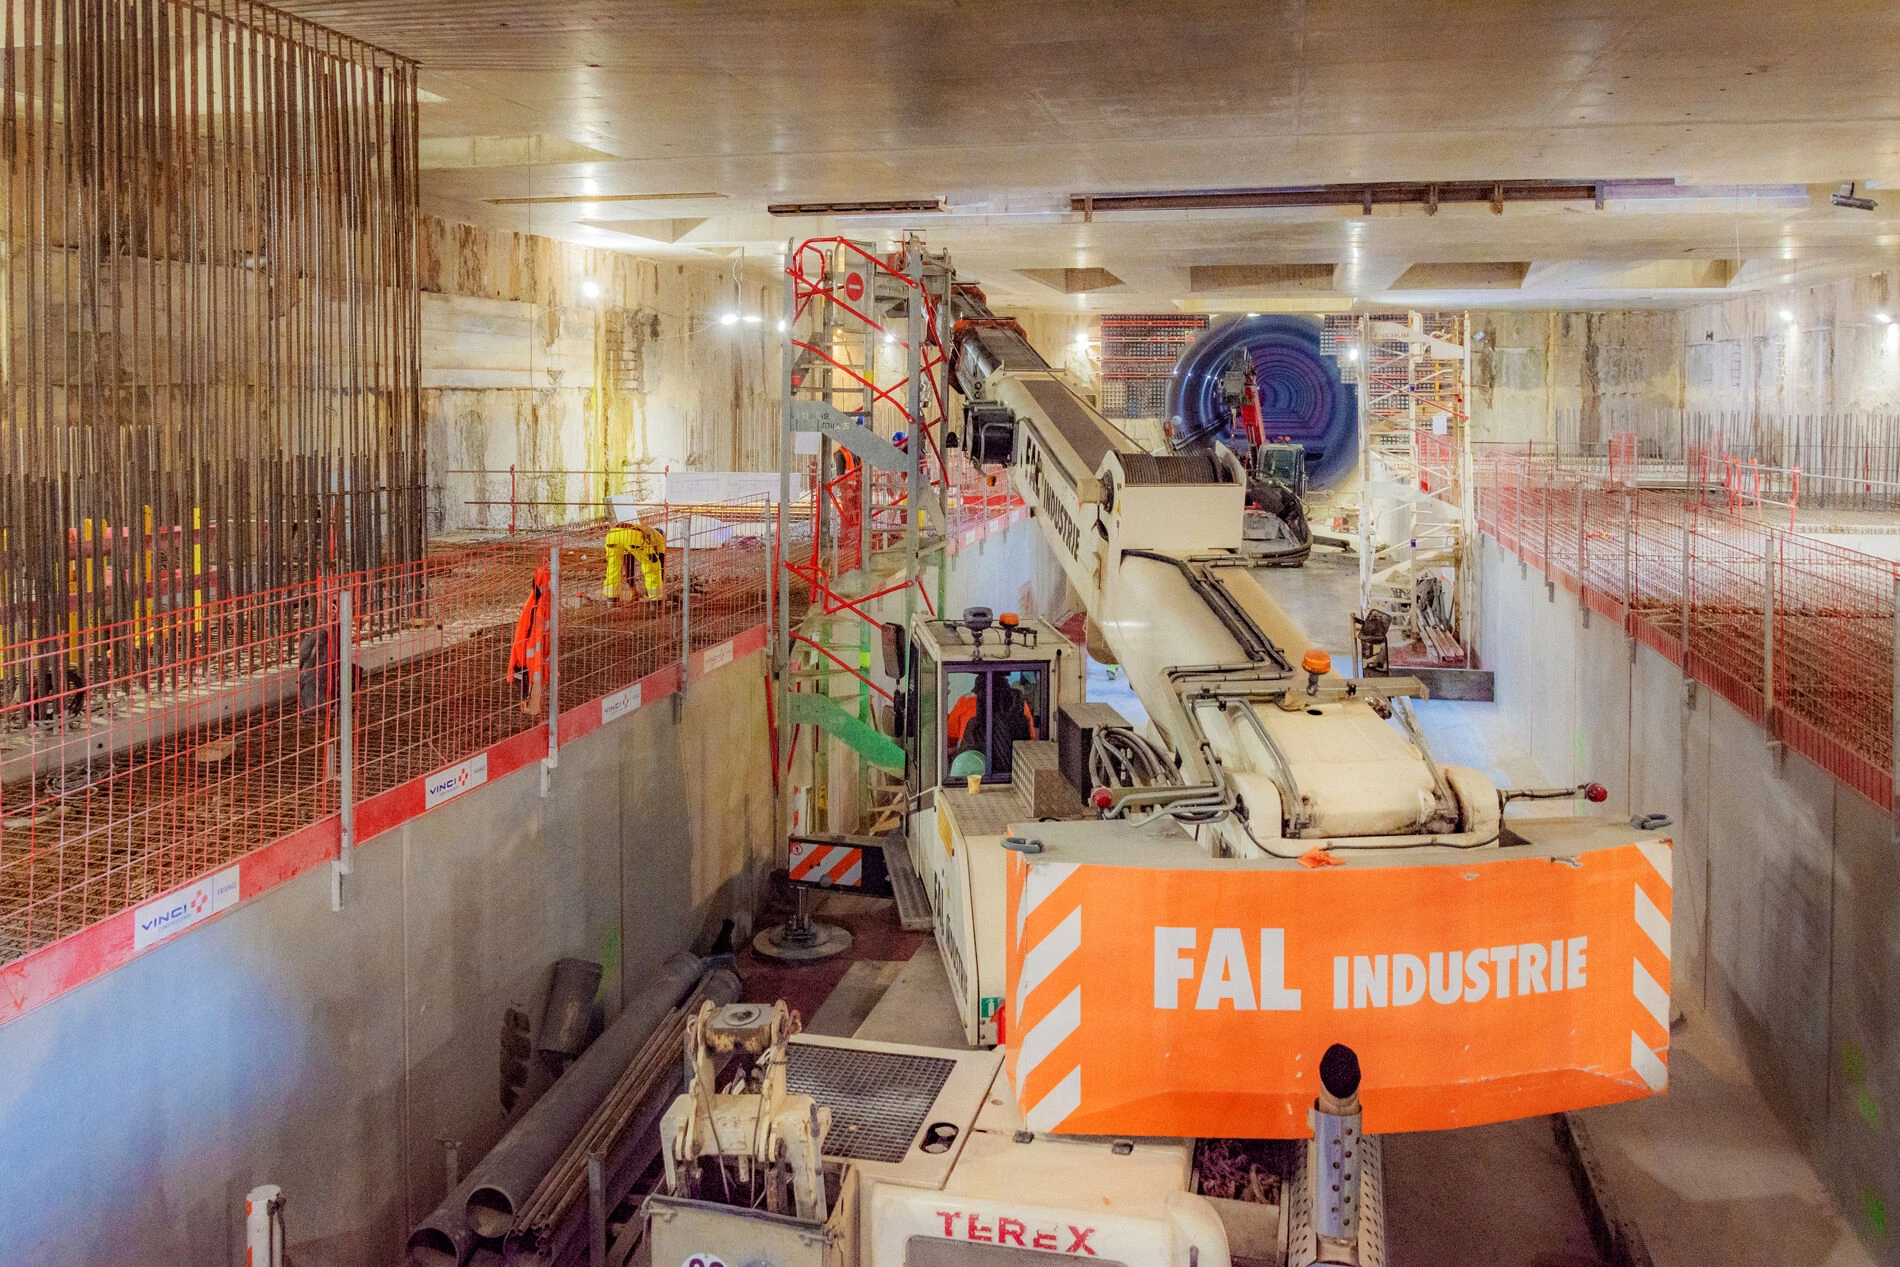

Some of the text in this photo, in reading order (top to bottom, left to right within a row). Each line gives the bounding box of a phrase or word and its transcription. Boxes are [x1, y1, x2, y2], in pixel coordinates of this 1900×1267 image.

[1043, 479, 1080, 562] INDUSTRIE
[429, 778, 457, 795] VINCI
[141, 904, 187, 930] VINCI
[1154, 926, 1588, 1011] FAL INDUSTRIE
[935, 1210, 1097, 1256] TEREX
